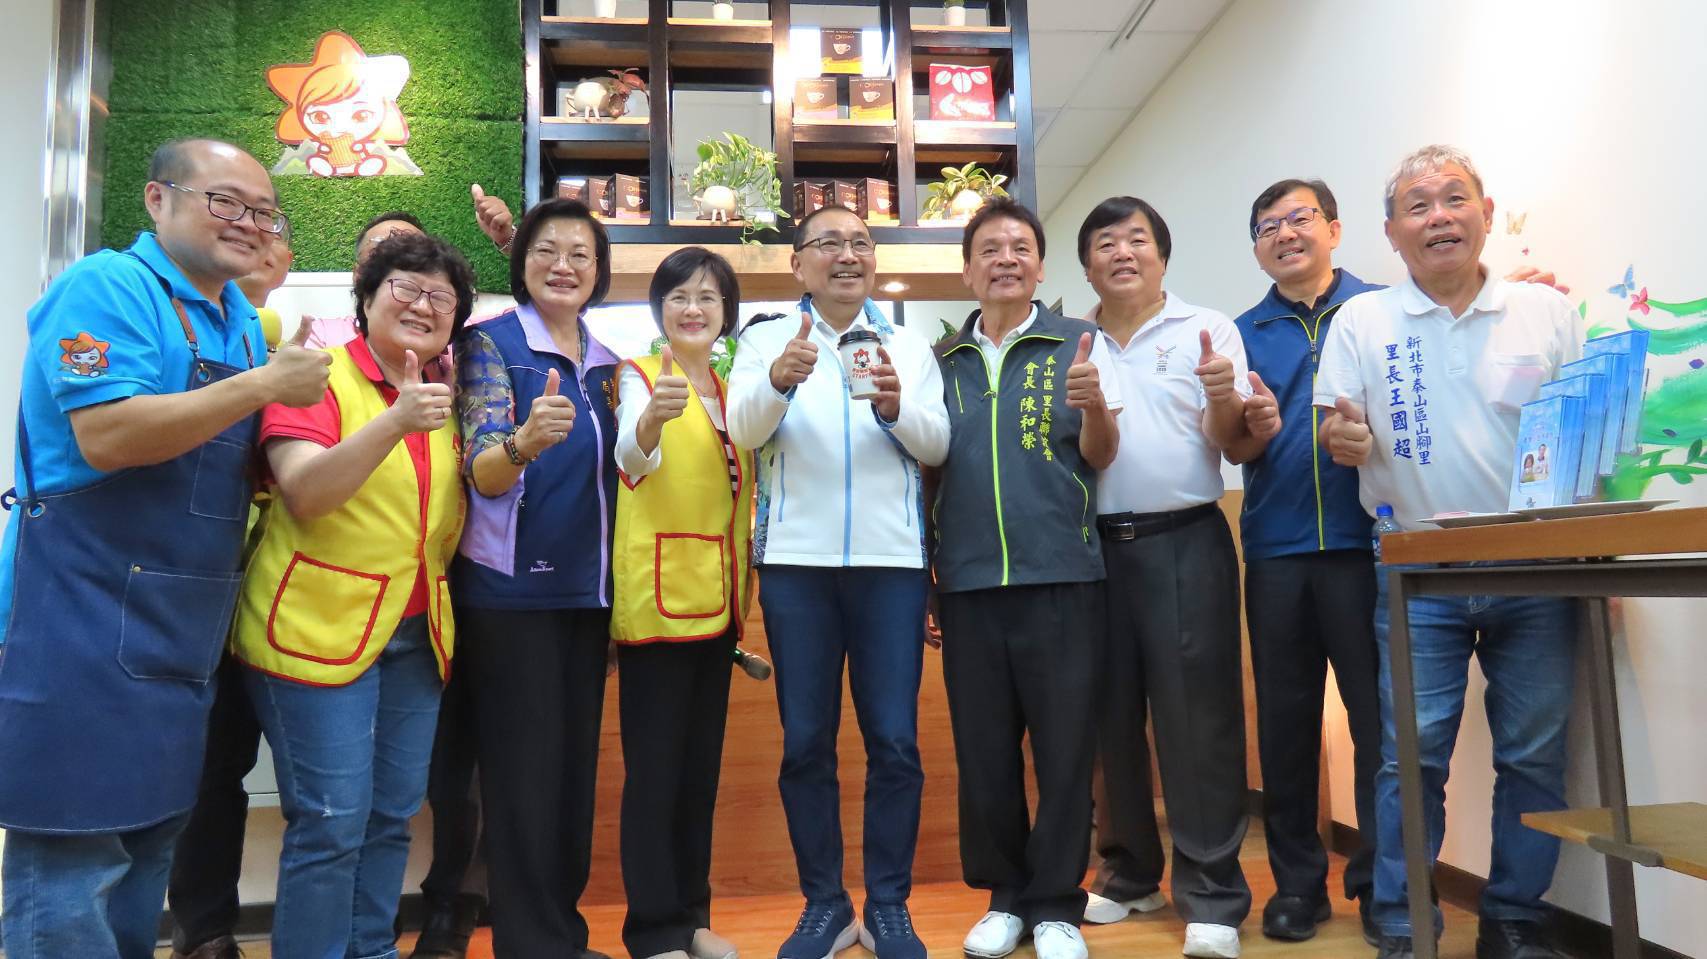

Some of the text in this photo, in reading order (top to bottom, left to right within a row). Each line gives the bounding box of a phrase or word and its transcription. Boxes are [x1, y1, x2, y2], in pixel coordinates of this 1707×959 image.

[1385, 343, 1412, 459] 里長王國超
[1406, 336, 1432, 465] 新北市泰山區山腳里
